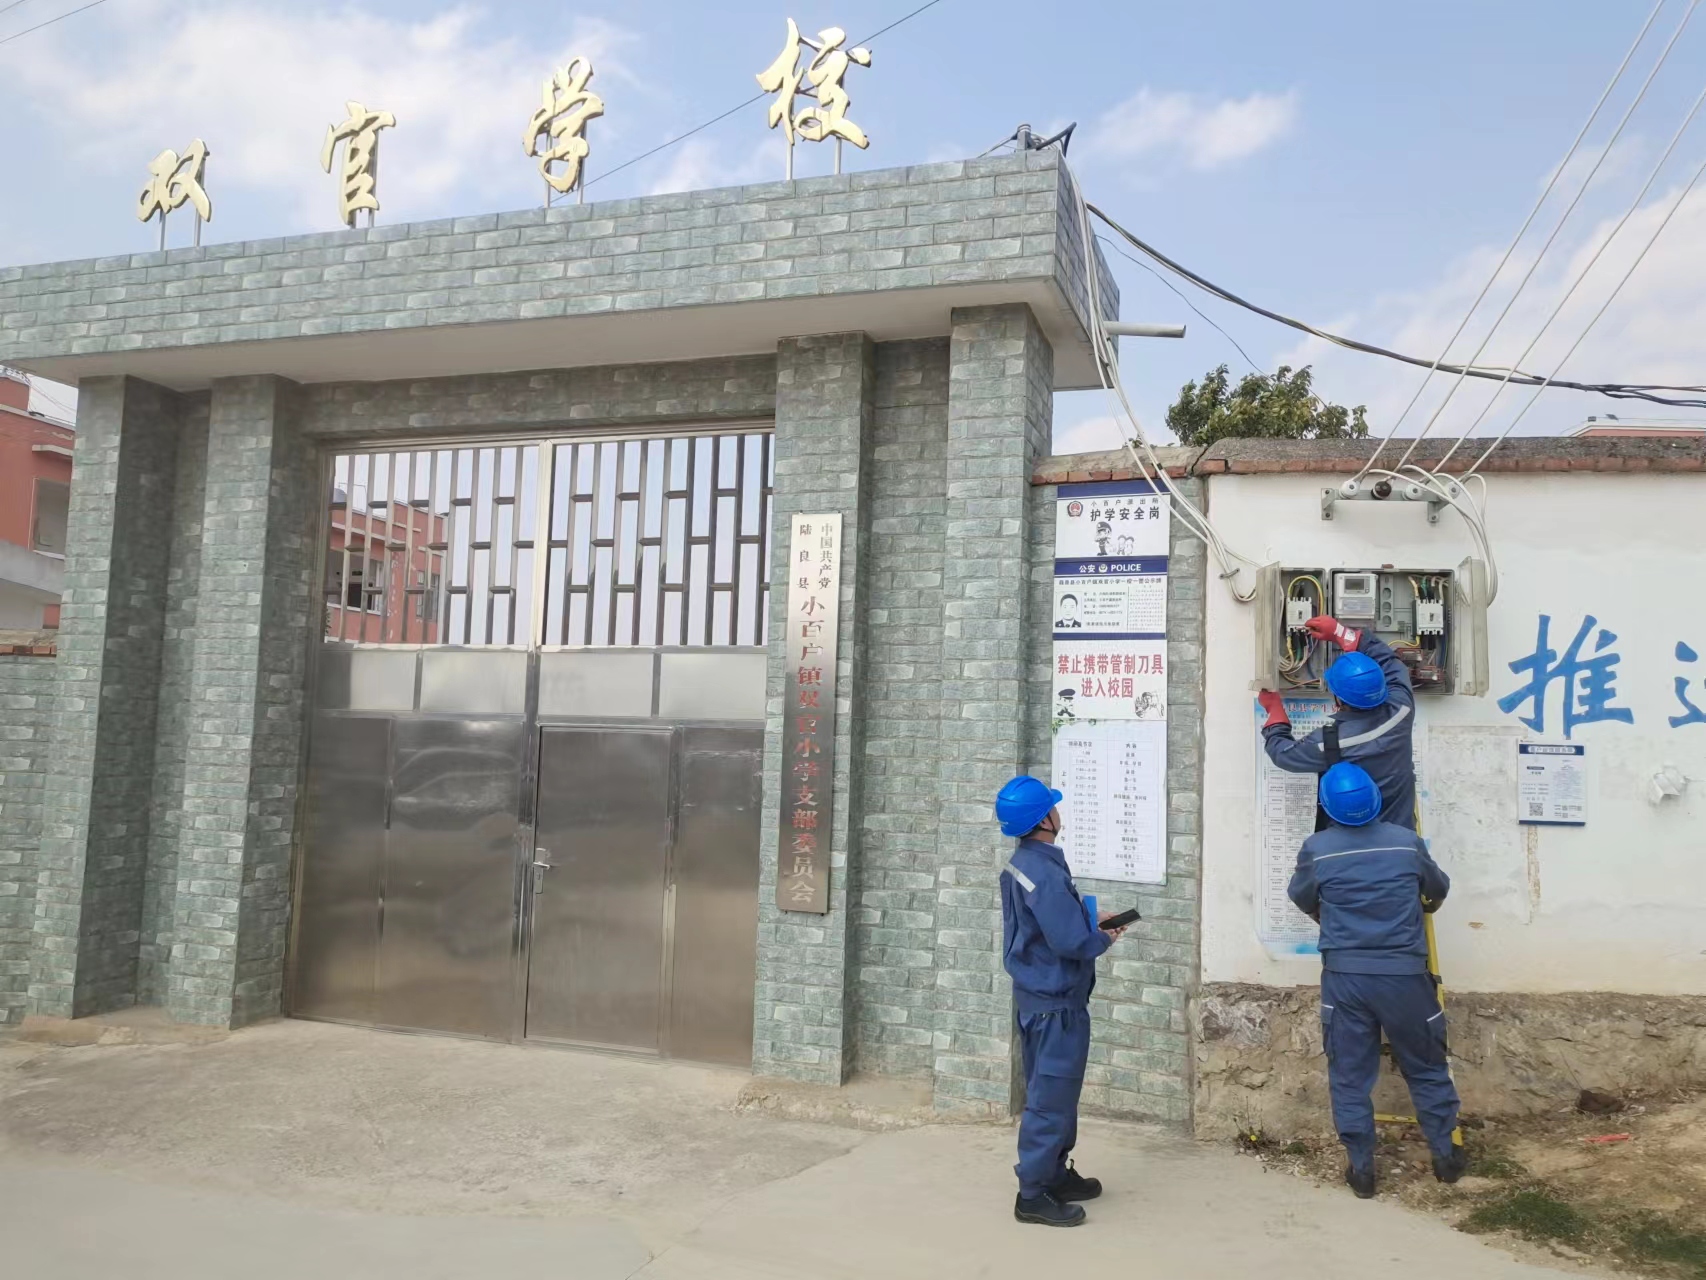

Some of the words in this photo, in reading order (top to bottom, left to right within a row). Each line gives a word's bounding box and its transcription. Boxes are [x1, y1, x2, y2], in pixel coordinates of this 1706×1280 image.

[137, 17, 872, 224] 双官学校
[1090, 506, 1160, 522] 护学安全岗
[797, 523, 812, 590] 陆良县
[819, 523, 833, 590] 中国共产党
[1079, 564, 1096, 573] 公安
[1110, 563, 1142, 572] POLICE
[1057, 653, 1164, 675] 禁止携带管制刀具
[1081, 677, 1134, 698] 进入校园
